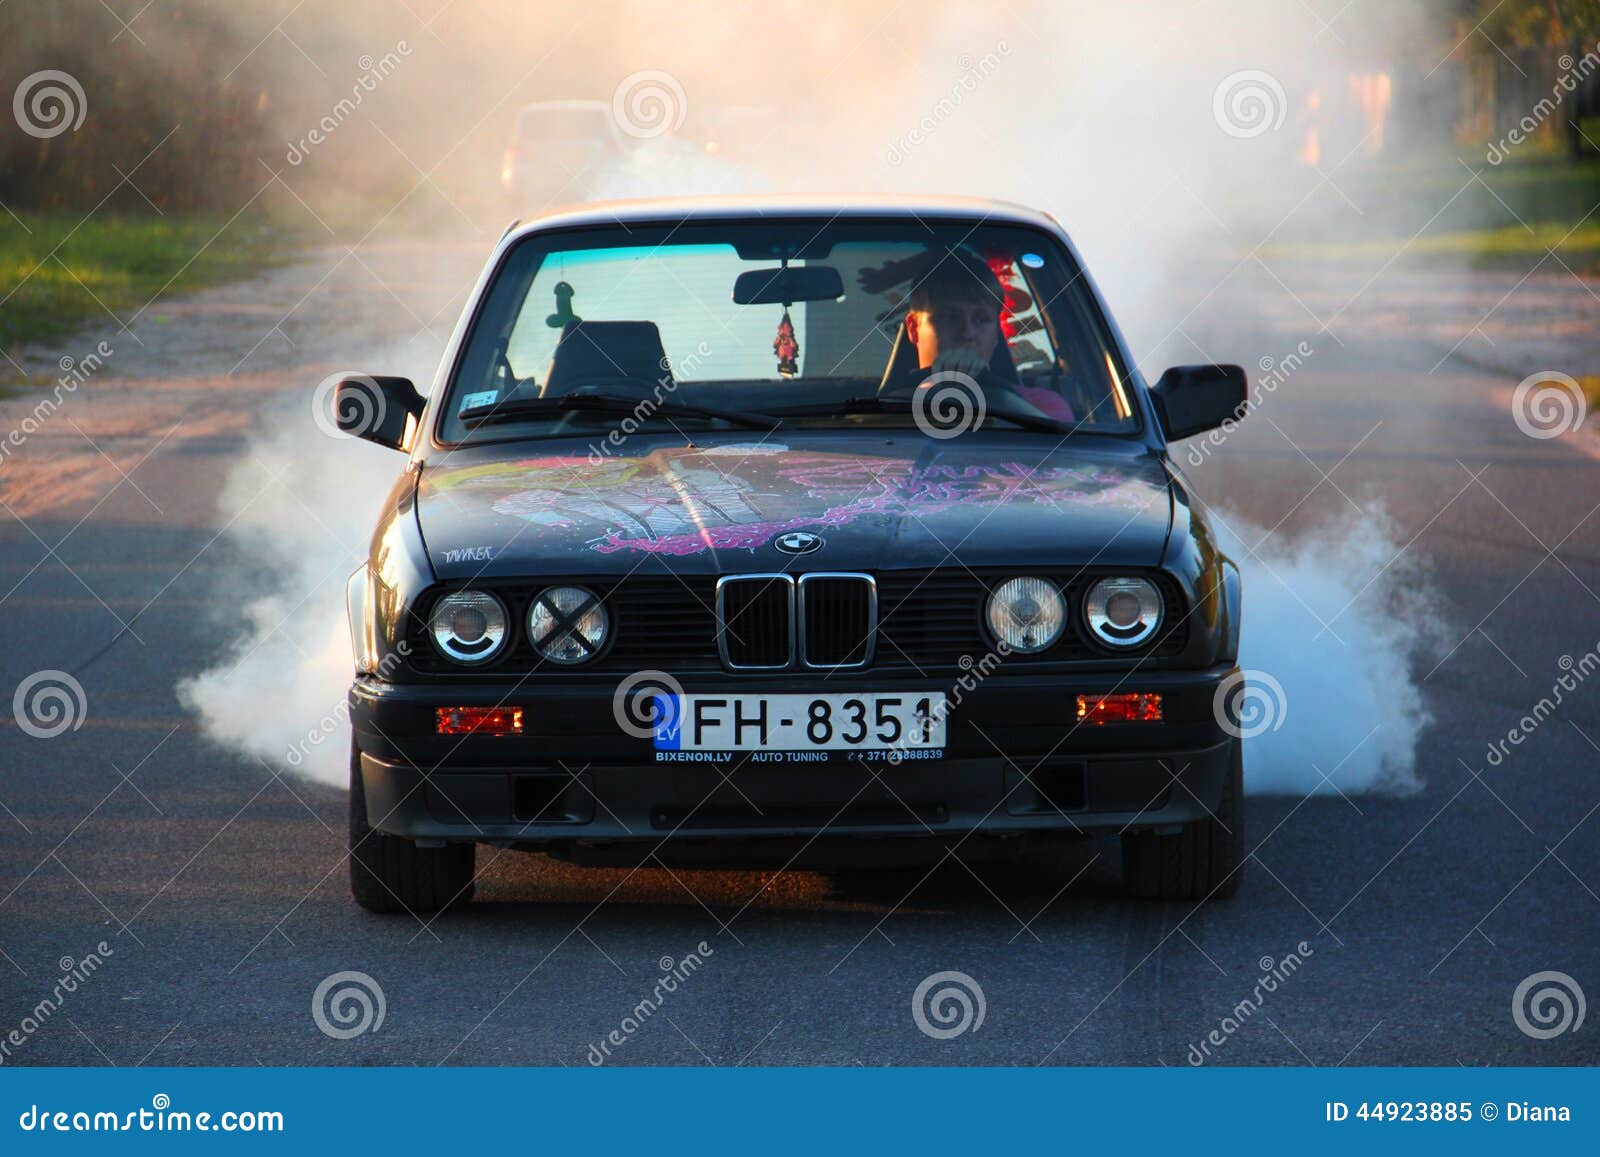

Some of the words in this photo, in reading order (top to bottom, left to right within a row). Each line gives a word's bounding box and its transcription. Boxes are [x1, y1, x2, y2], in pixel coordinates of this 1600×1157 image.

[656, 728, 678, 741] LV
[656, 752, 732, 762] BIXENON.LV
[751, 752, 783, 762] AUTO
[785, 752, 829, 762] TUNING
